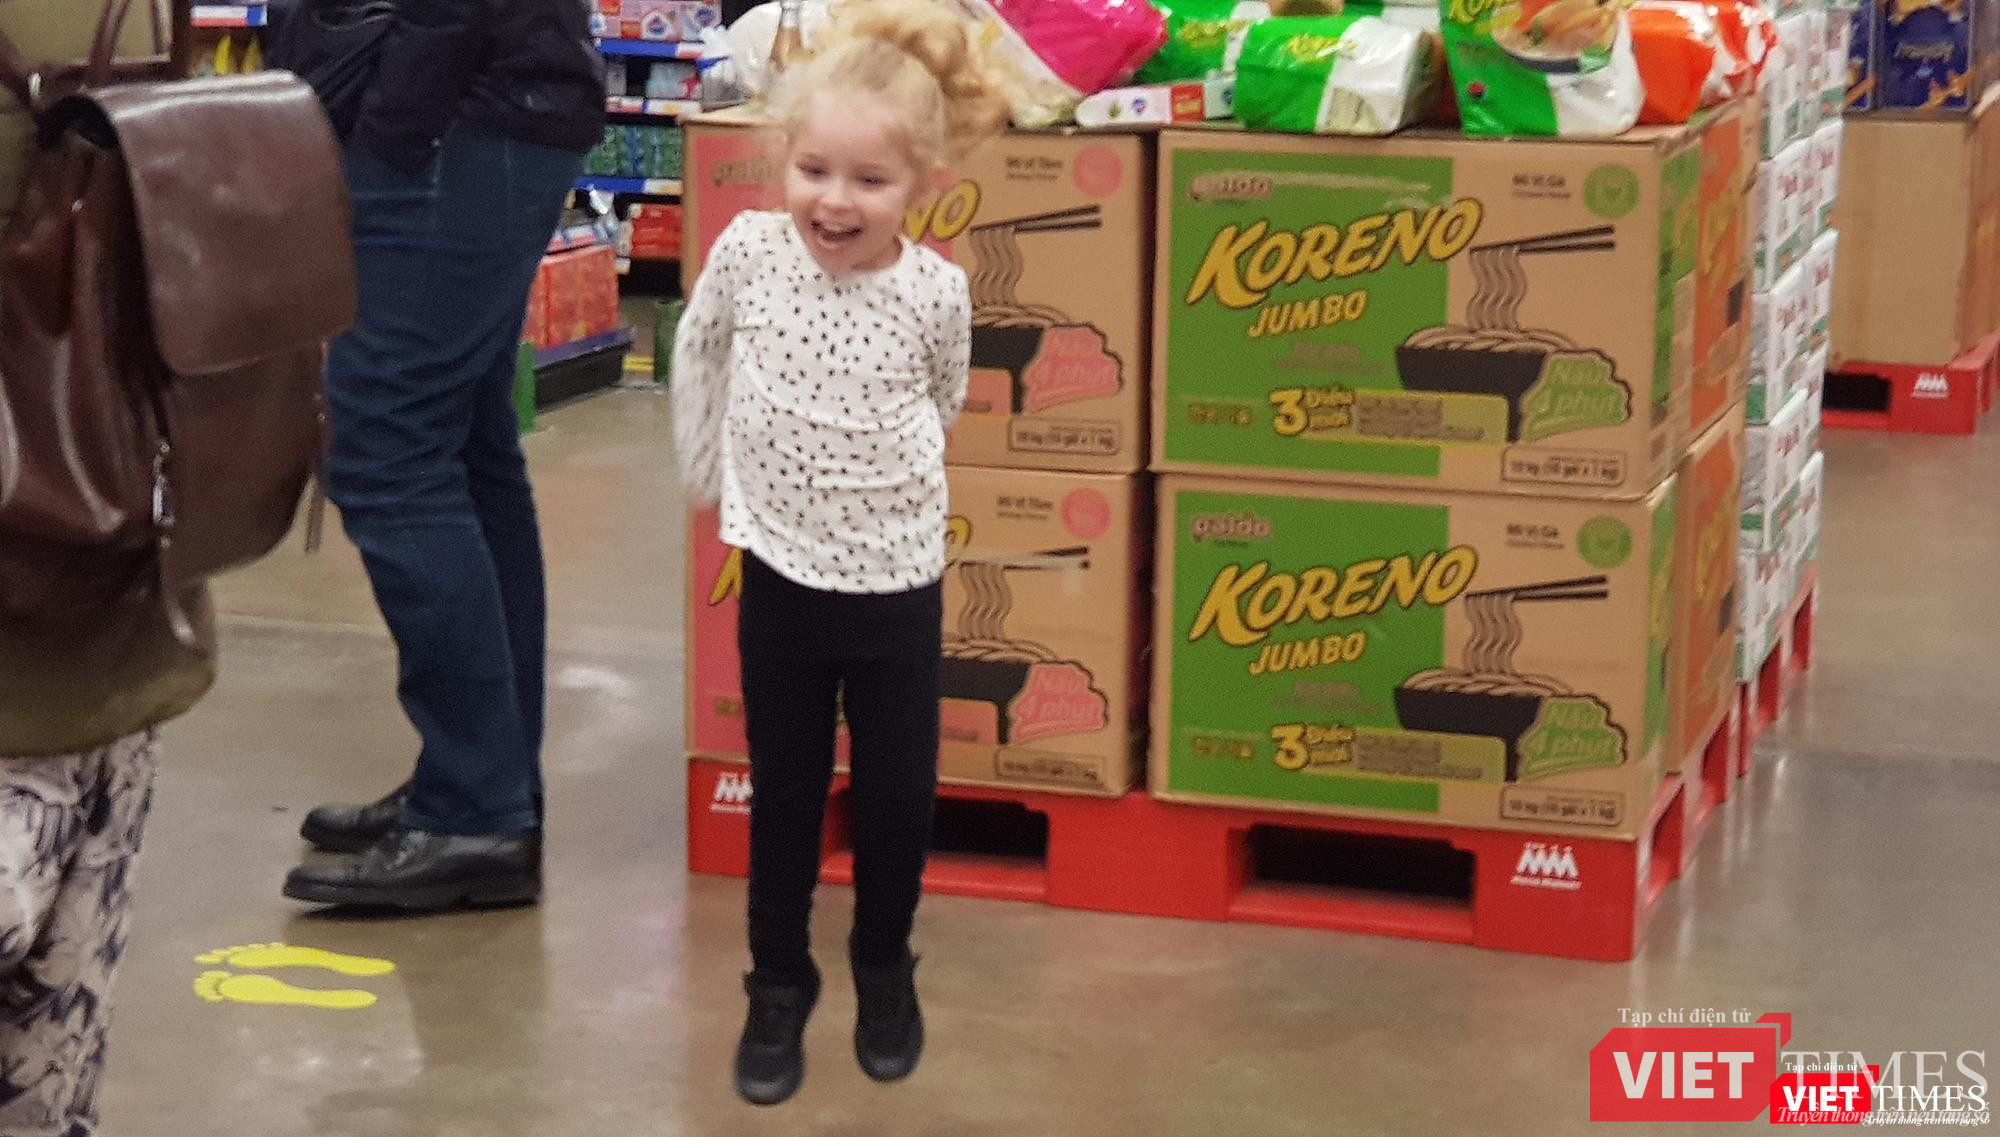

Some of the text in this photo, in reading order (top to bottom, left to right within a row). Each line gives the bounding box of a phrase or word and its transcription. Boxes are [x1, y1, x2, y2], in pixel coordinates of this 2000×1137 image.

[1185, 198, 1482, 309] KORENO
[1248, 289, 1369, 338] JUMBO
[1269, 388, 1309, 436] 3
[1187, 545, 1478, 647] KORENO
[1248, 631, 1367, 675] JUMBO
[1270, 724, 1309, 770] 3
